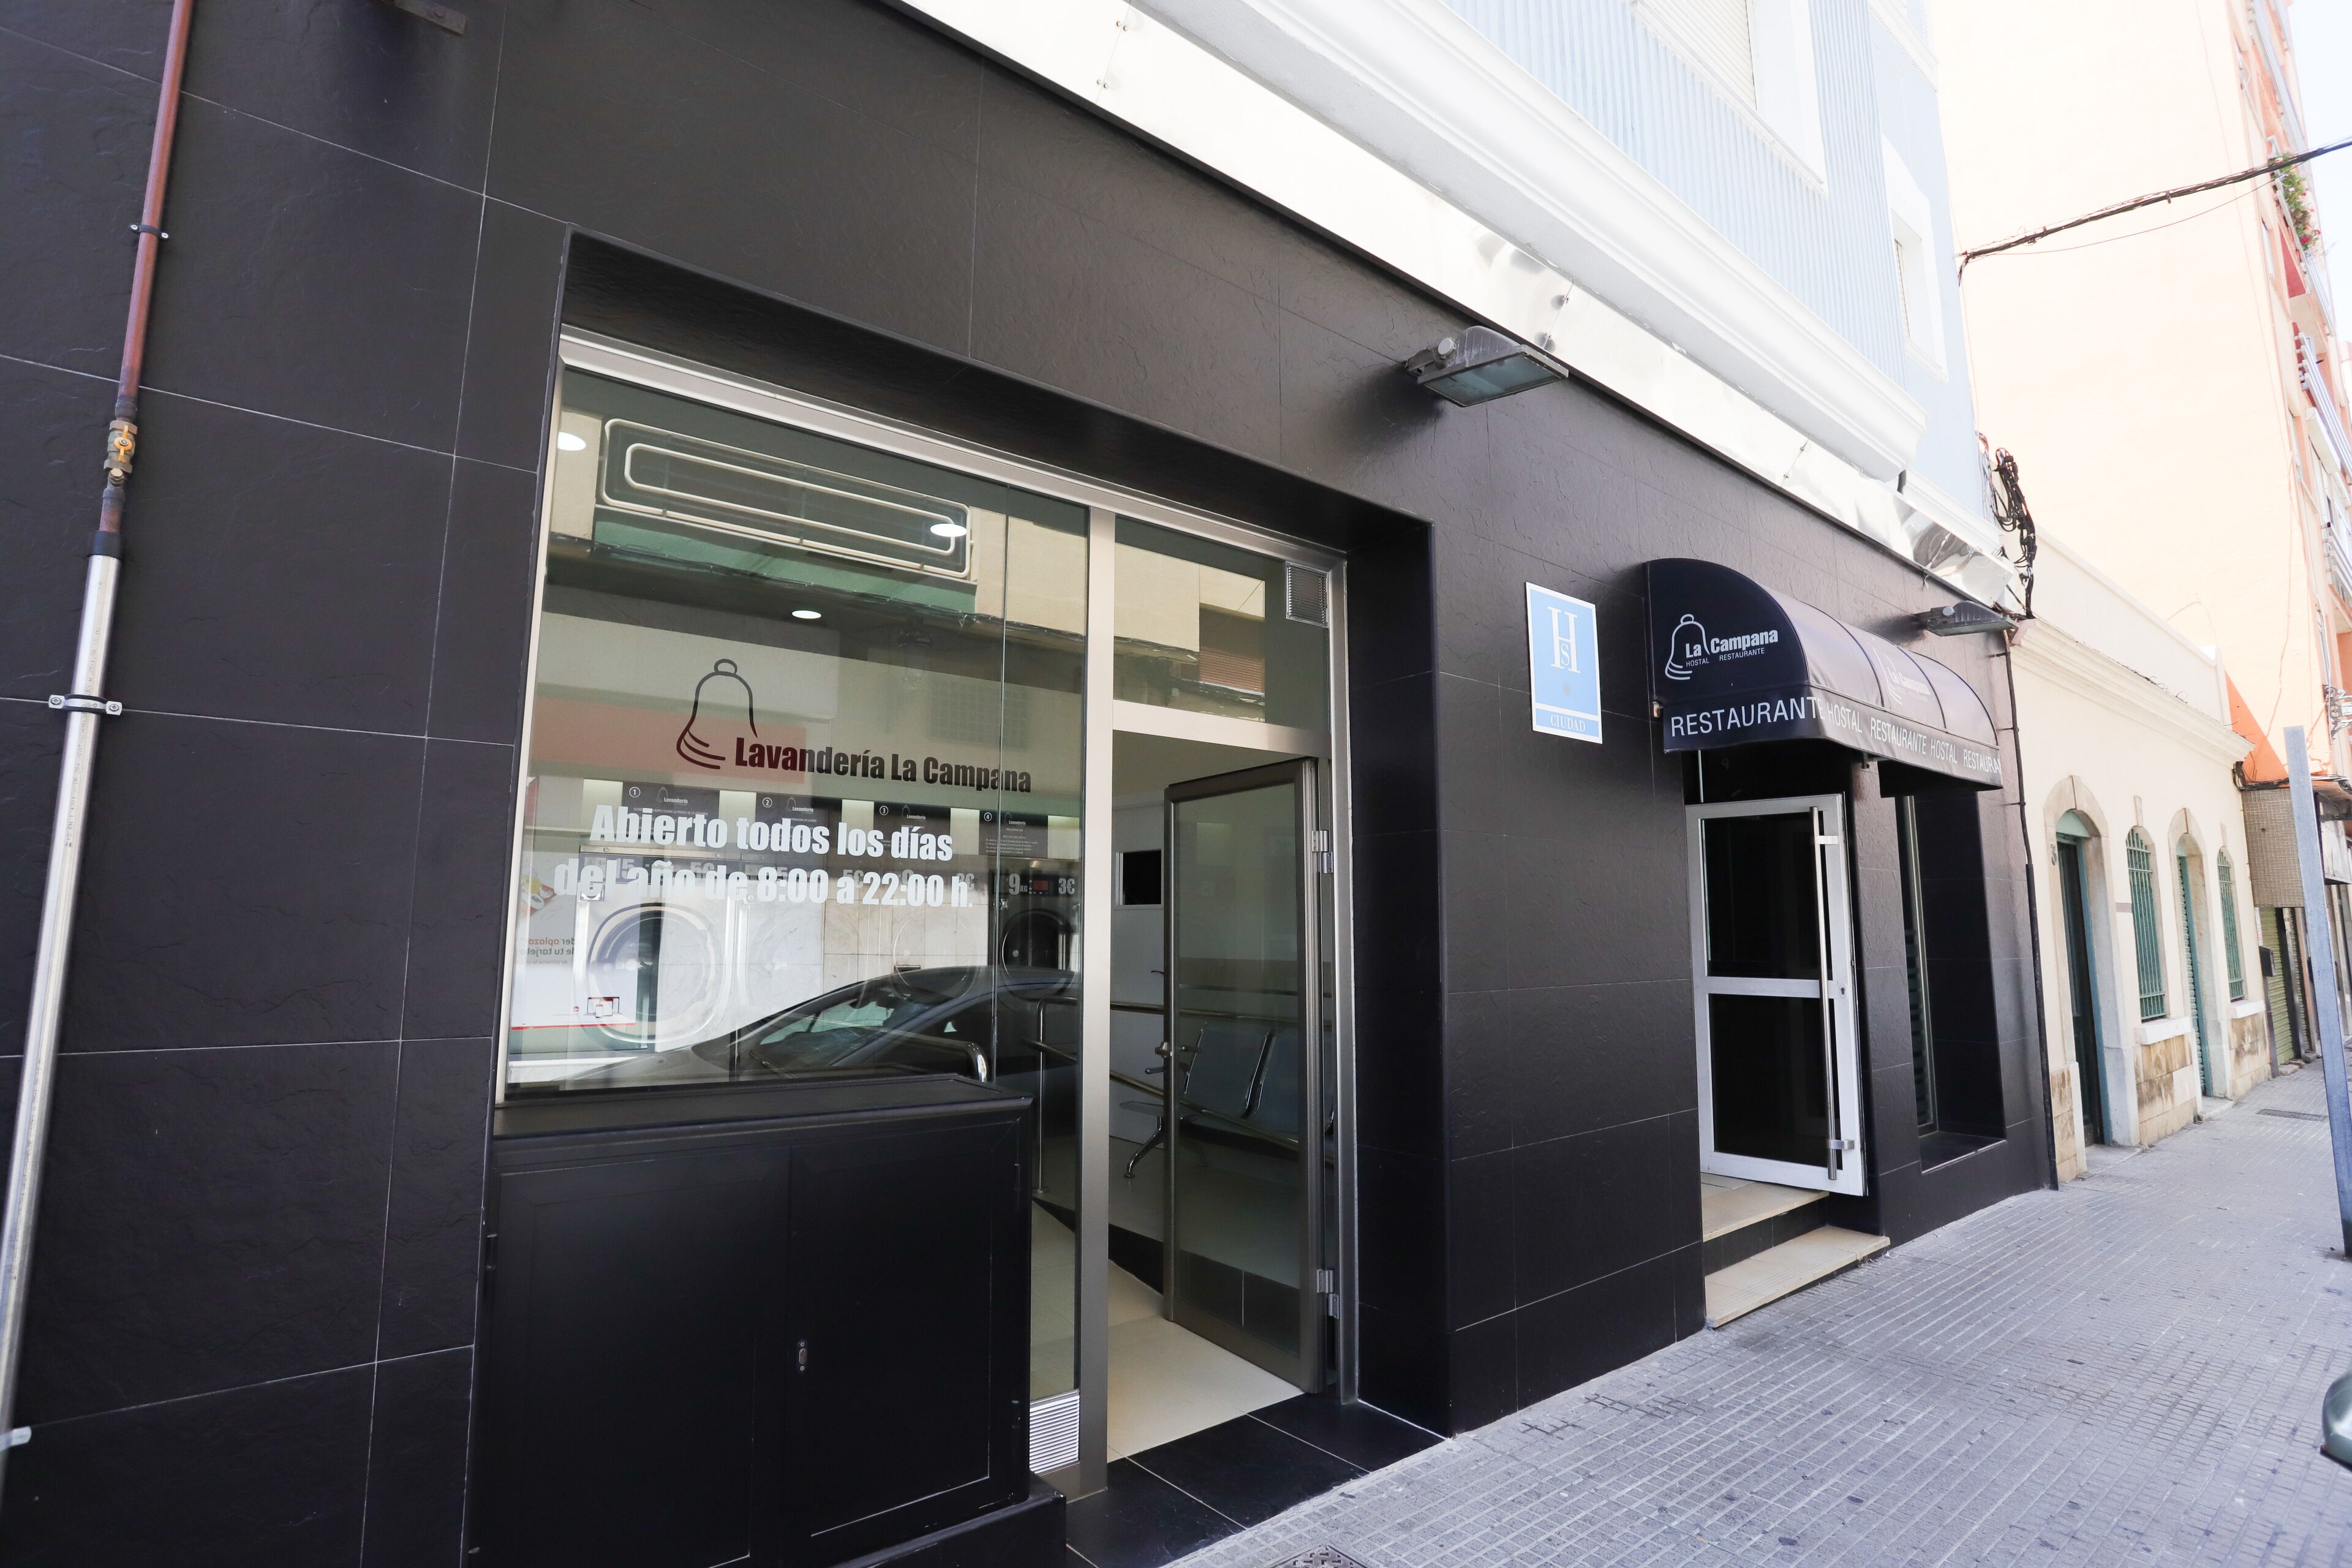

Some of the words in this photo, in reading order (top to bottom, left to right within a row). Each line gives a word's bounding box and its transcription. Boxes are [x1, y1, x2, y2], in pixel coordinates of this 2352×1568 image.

[1686, 643, 1702, 658] La
[1711, 630, 1778, 654] Campana
[1686, 657, 1709, 668] HOSTAL
[1719, 647, 1765, 662] RESTAURANTE
[1550, 714, 1586, 732] CIUDAD
[1671, 696, 1825, 737] RESTAURANTE
[1826, 704, 1863, 733] HOSTAL
[1871, 717, 1927, 755] RESTAURANTE
[1930, 738, 1958, 764] HOSTAL
[735, 737, 885, 779] Lavandería
[891, 753, 917, 782] La
[923, 756, 1031, 793] Campana
[589, 804, 728, 848] Abierto
[736, 817, 830, 854] todos
[837, 822, 884, 856] los
[891, 826, 953, 861] días
[554, 858, 617, 897] del
[627, 859, 695, 899] año
[704, 865, 748, 901] de
[756, 866, 829, 904] 8:00
[836, 876, 855, 905] a
[862, 871, 944, 907] 22:00
[951, 876, 973, 908] h.
[1058, 878, 1076, 895] 3€
